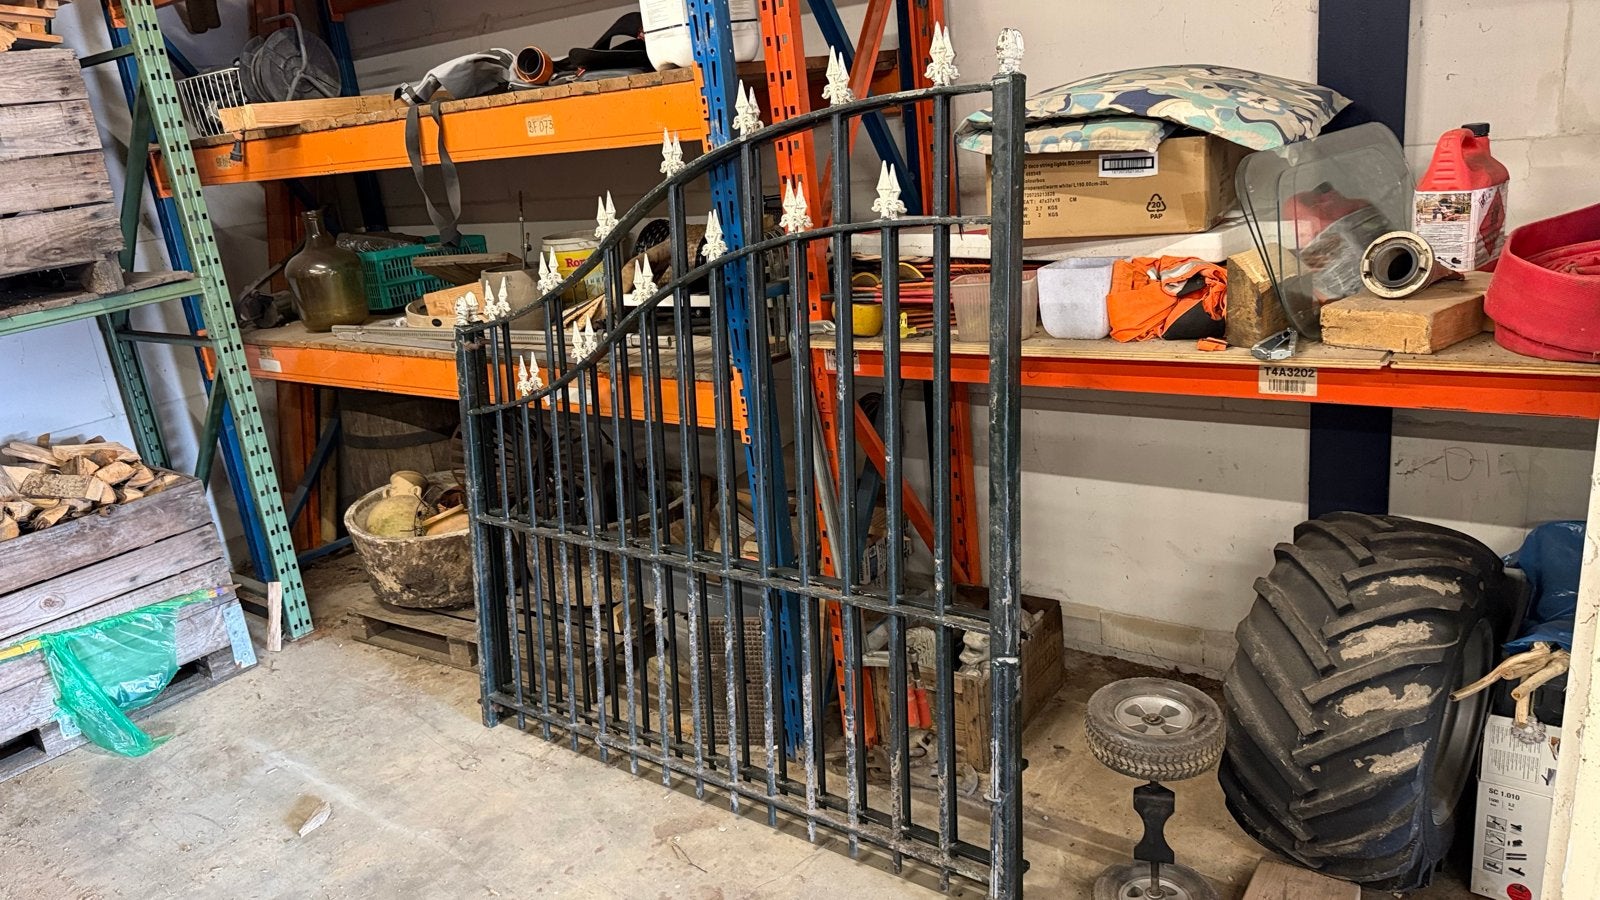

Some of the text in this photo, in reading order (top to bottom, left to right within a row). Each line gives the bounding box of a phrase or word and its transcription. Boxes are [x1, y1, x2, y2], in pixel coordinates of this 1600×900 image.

[1151, 201, 1162, 209] 20
[1264, 366, 1315, 378] T4A3202
[1488, 787, 1520, 801] SC 1.010
